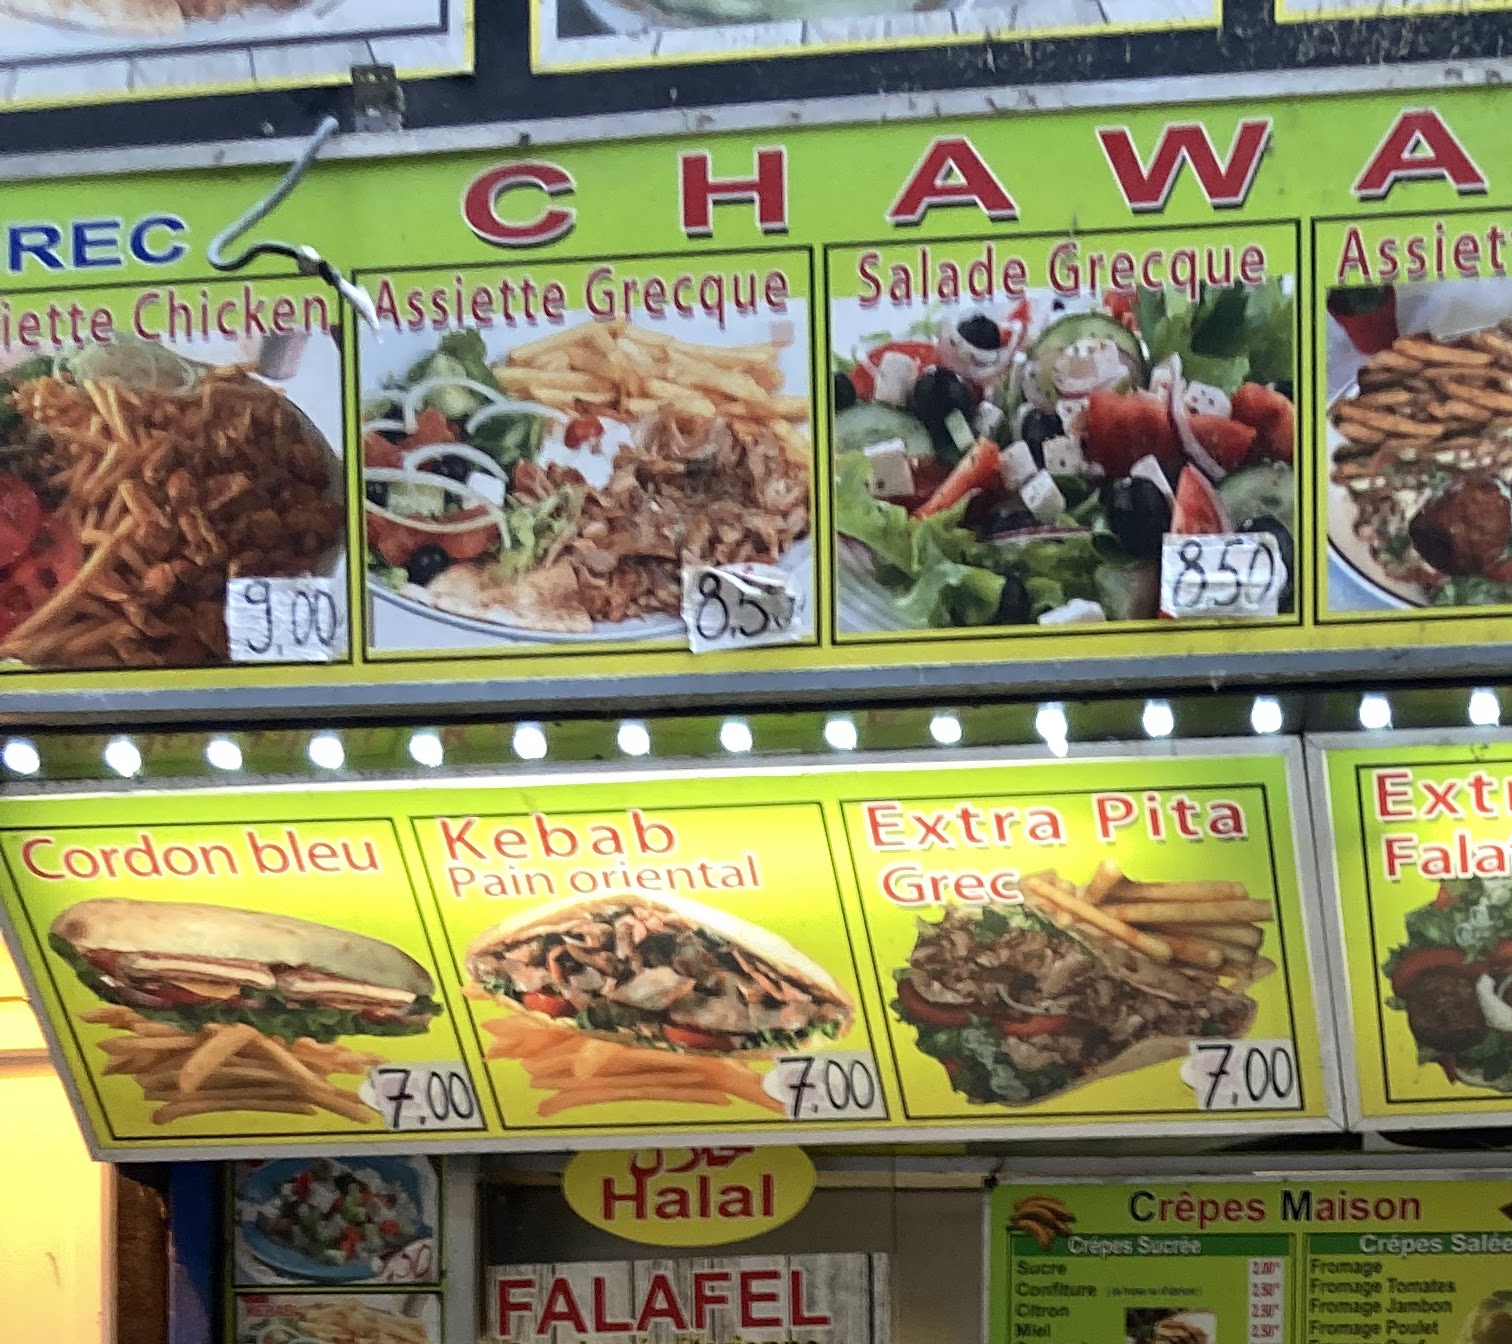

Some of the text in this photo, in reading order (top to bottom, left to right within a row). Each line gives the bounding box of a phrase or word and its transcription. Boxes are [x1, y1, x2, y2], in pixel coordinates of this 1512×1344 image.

[375, 264, 789, 336] Assiette Grecque
[857, 235, 1266, 309] Salade Grecque
[133, 283, 332, 344] Chicken
[441, 807, 677, 860] Kebab
[865, 795, 1247, 851] Extra Pita
[21, 831, 380, 881] Cordon bleu
[448, 857, 762, 899] Pain oriental
[880, 862, 1022, 906] Grec
[376, 1068, 472, 1130] 7.00
[780, 1056, 876, 1116] 7.00
[1198, 1045, 1297, 1111] 7.00
[603, 1174, 775, 1220] Halal
[1127, 1189, 1421, 1229] Crêpes Maison
[499, 1269, 830, 1336] FALAFEL
